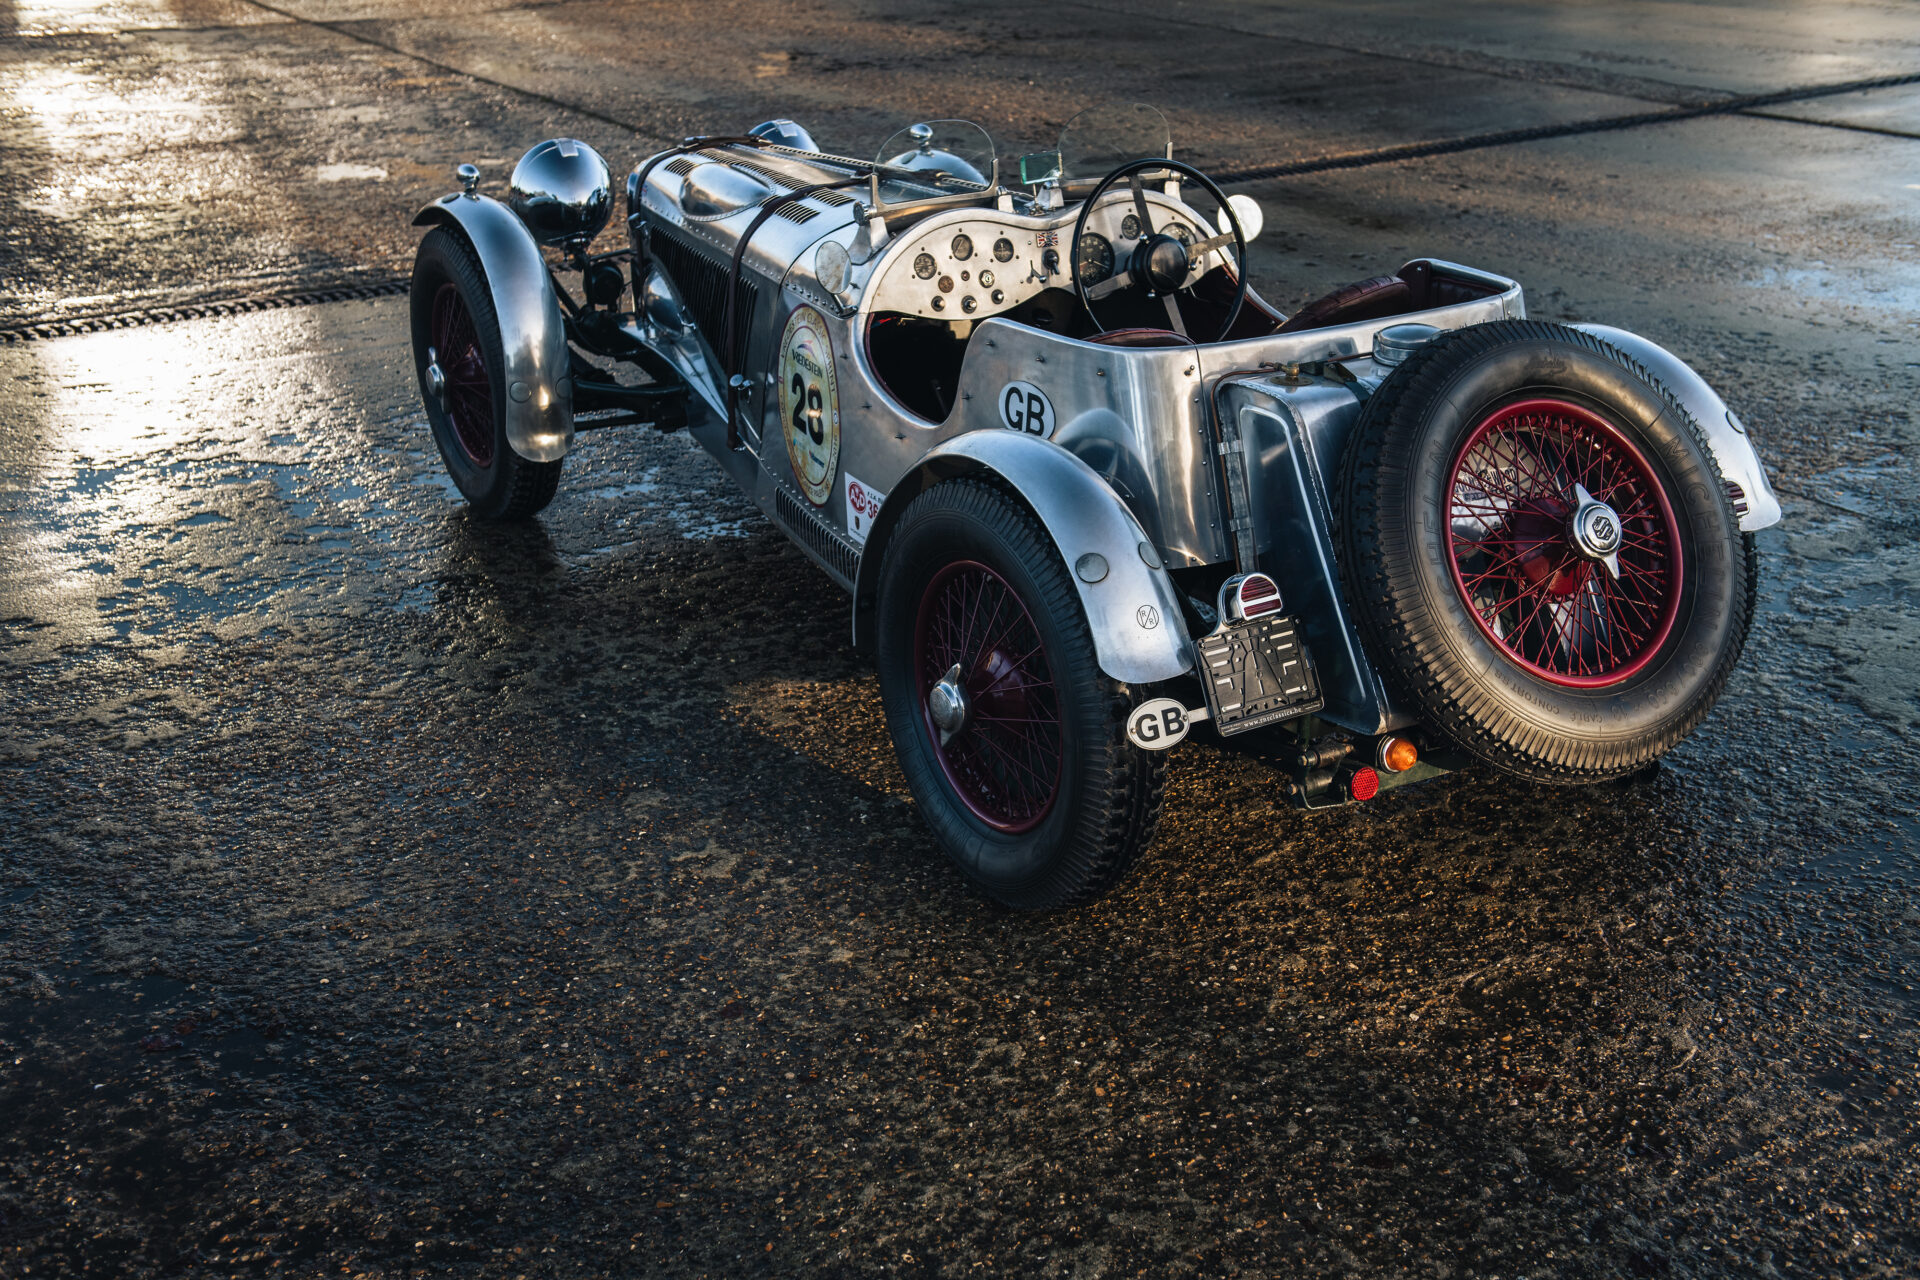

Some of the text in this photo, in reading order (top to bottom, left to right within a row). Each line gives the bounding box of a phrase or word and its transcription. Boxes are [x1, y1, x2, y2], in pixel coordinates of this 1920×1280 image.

[791, 349, 823, 379] VREDESTEIN
[791, 372, 824, 446] 28
[1004, 386, 1045, 437] GB
[1422, 439, 1481, 646] MICHELIN
[1662, 432, 1725, 631] MICHELIN
[1134, 705, 1186, 743] GB
[1511, 684, 1560, 715] CONFORT
[888, 697, 972, 846] MICHELIN
